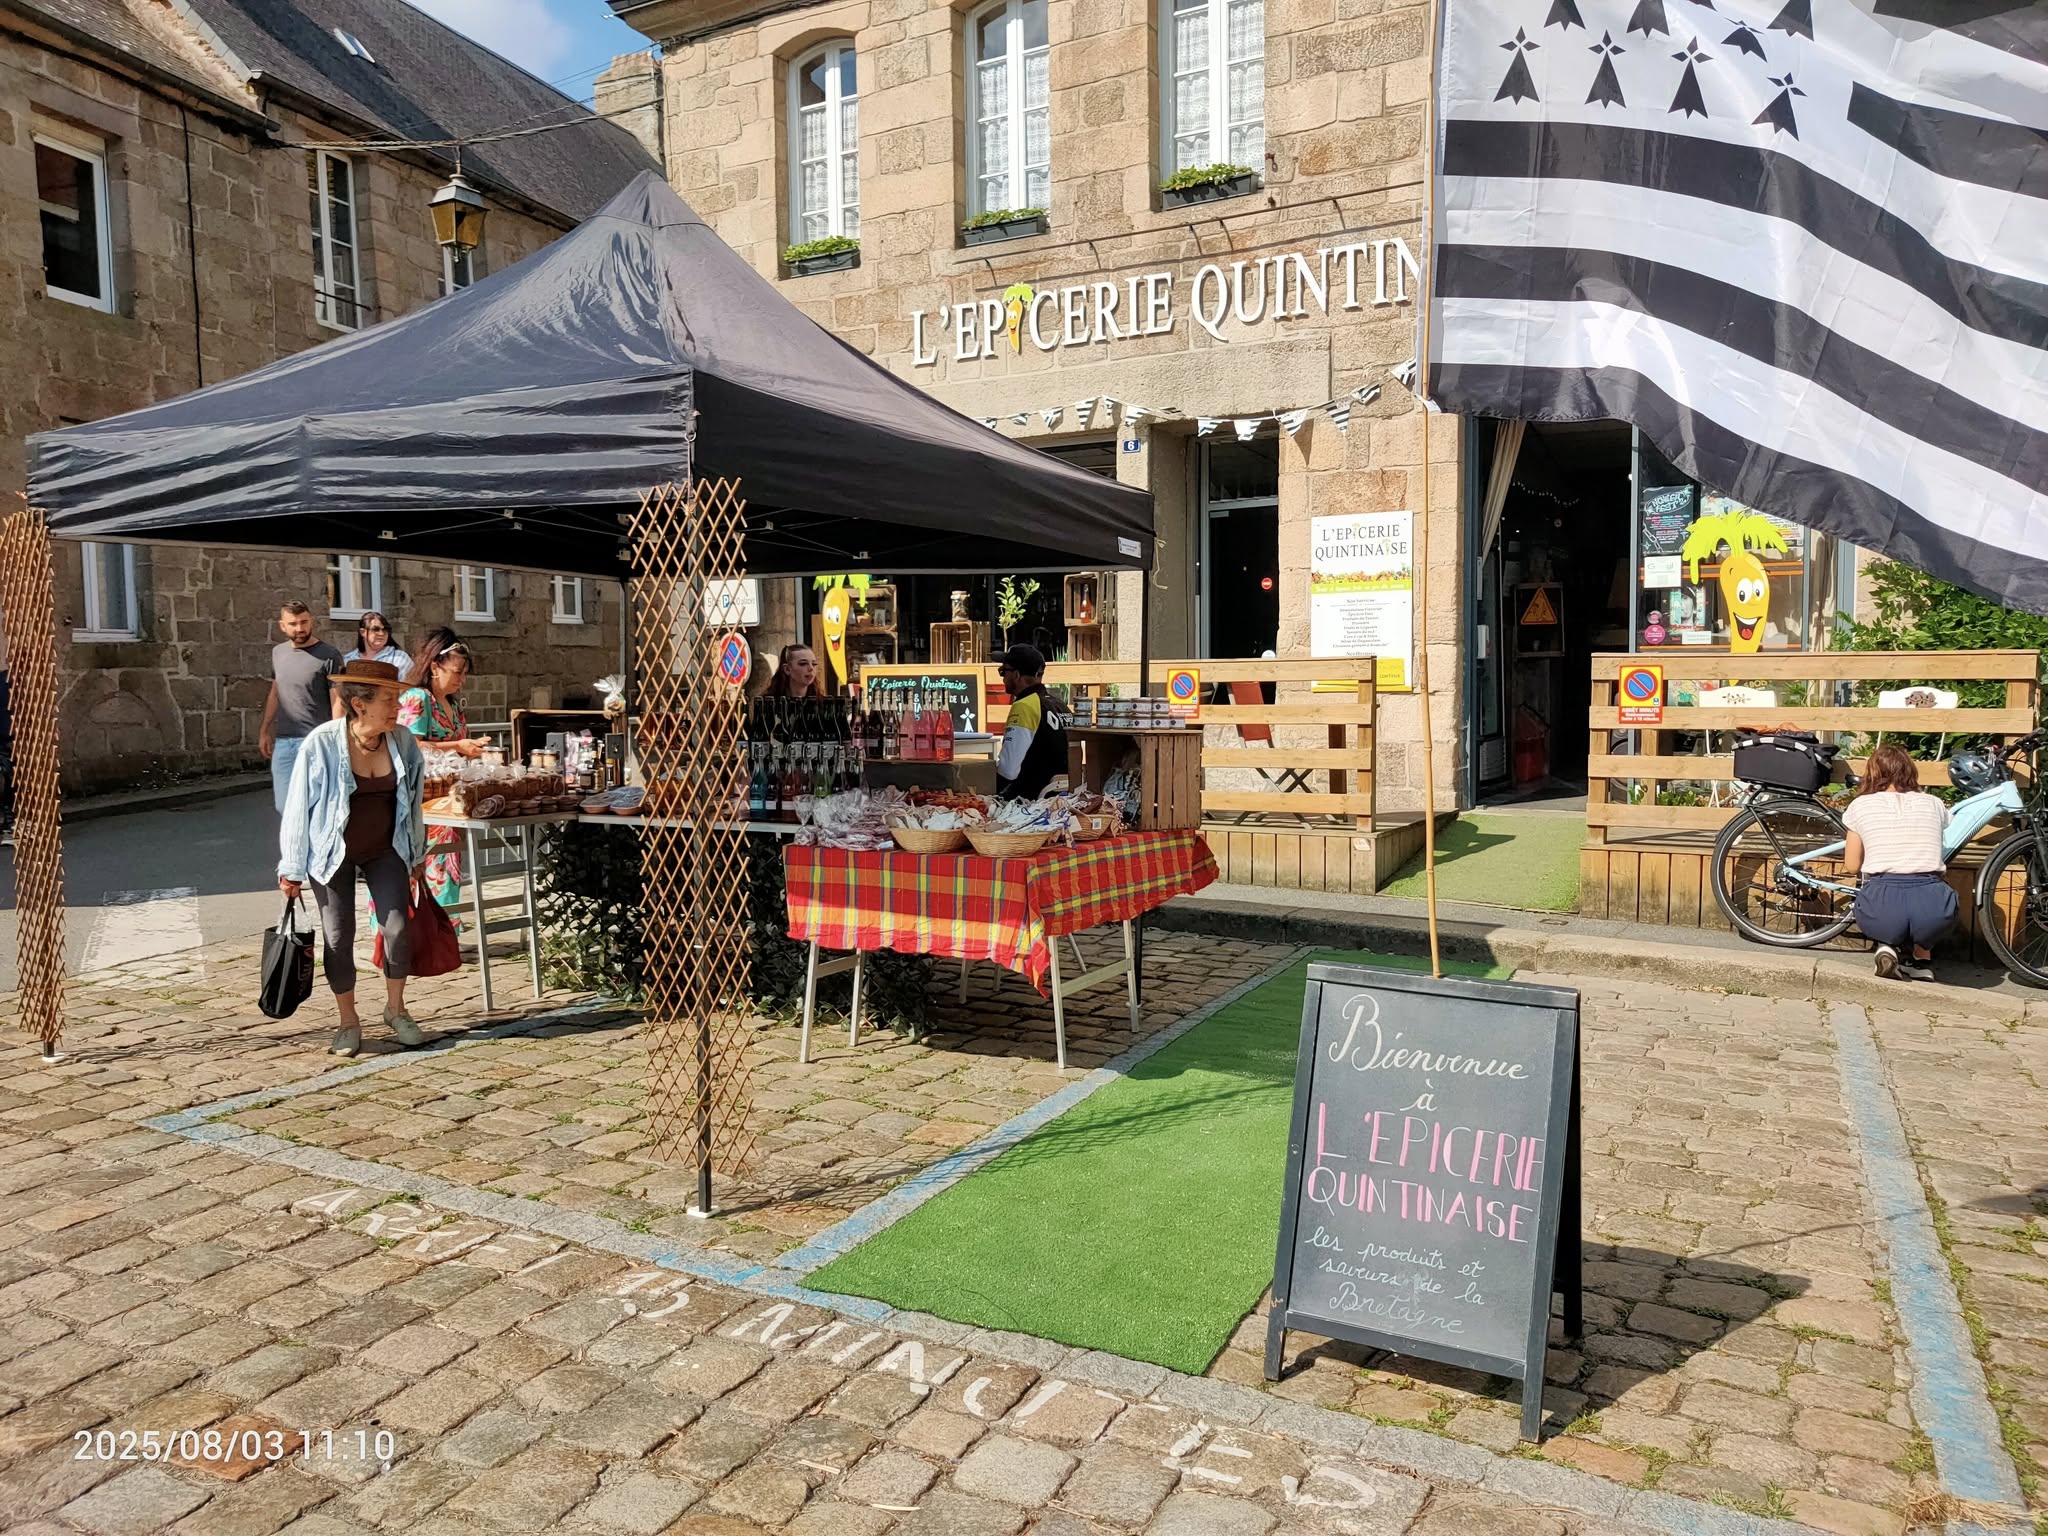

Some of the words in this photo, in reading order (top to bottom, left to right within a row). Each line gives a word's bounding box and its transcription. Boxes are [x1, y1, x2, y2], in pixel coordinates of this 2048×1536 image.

[1127, 441, 1135, 450] 6
[961, 695, 970, 704] LA
[1328, 994, 1529, 1079] Bienvenue
[1400, 1079, 1437, 1111] à
[1316, 1102, 1545, 1192] L'EPICERIE
[1307, 1165, 1534, 1243] QUINTINAISE
[1304, 1226, 1344, 1251] les
[1357, 1241, 1447, 1270] produits
[1457, 1260, 1486, 1278] et
[1319, 1256, 1402, 1287] saveurs
[1420, 1276, 1446, 1293] de
[1454, 1282, 1486, 1306] la
[1328, 1281, 1466, 1335] Bretagne
